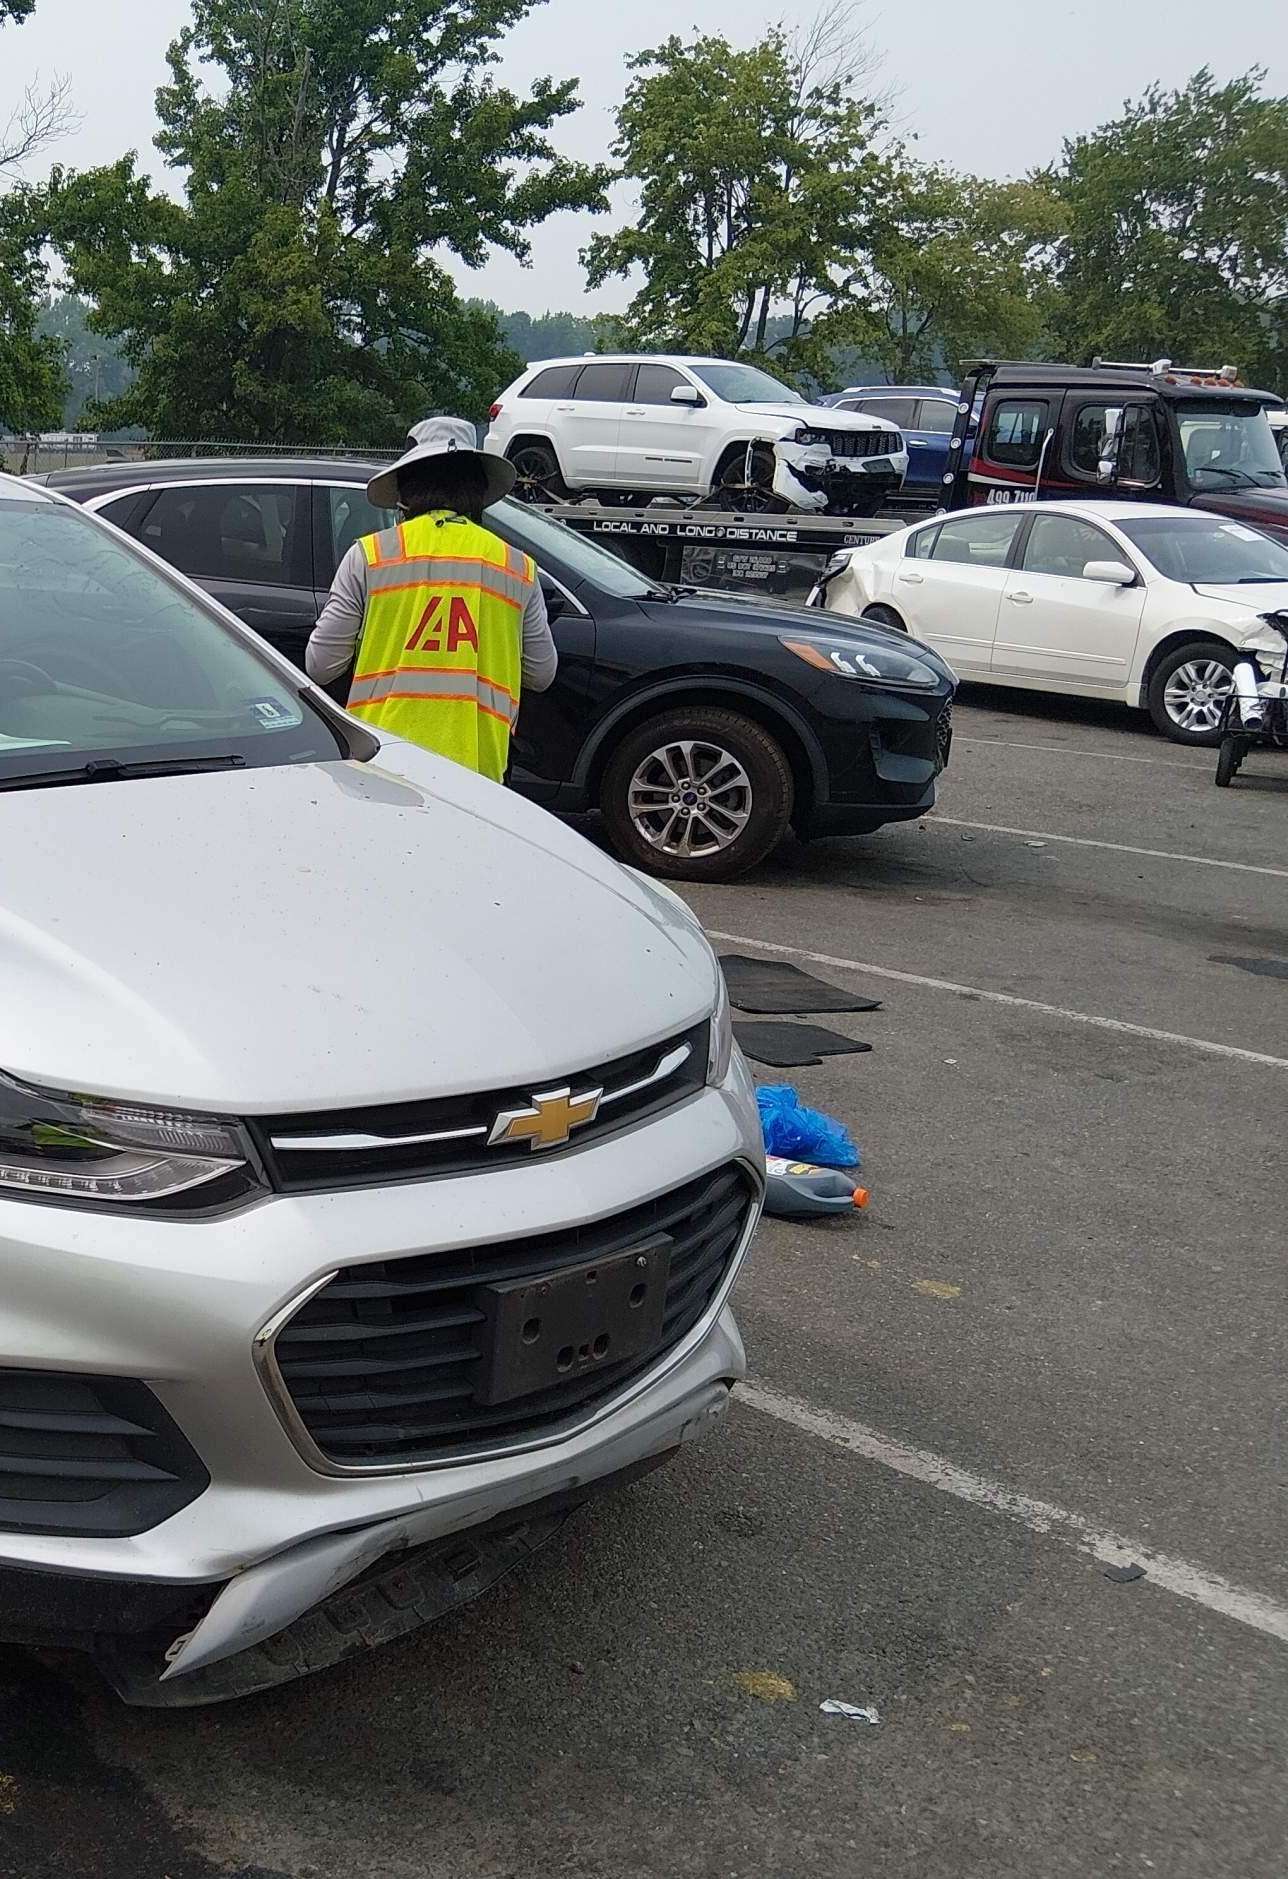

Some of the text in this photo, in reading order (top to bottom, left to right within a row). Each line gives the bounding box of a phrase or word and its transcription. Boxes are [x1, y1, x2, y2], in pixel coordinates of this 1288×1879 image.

[987, 489, 1010, 504] 499
[593, 521, 798, 542] LOCAL AND LONG DISTANCE
